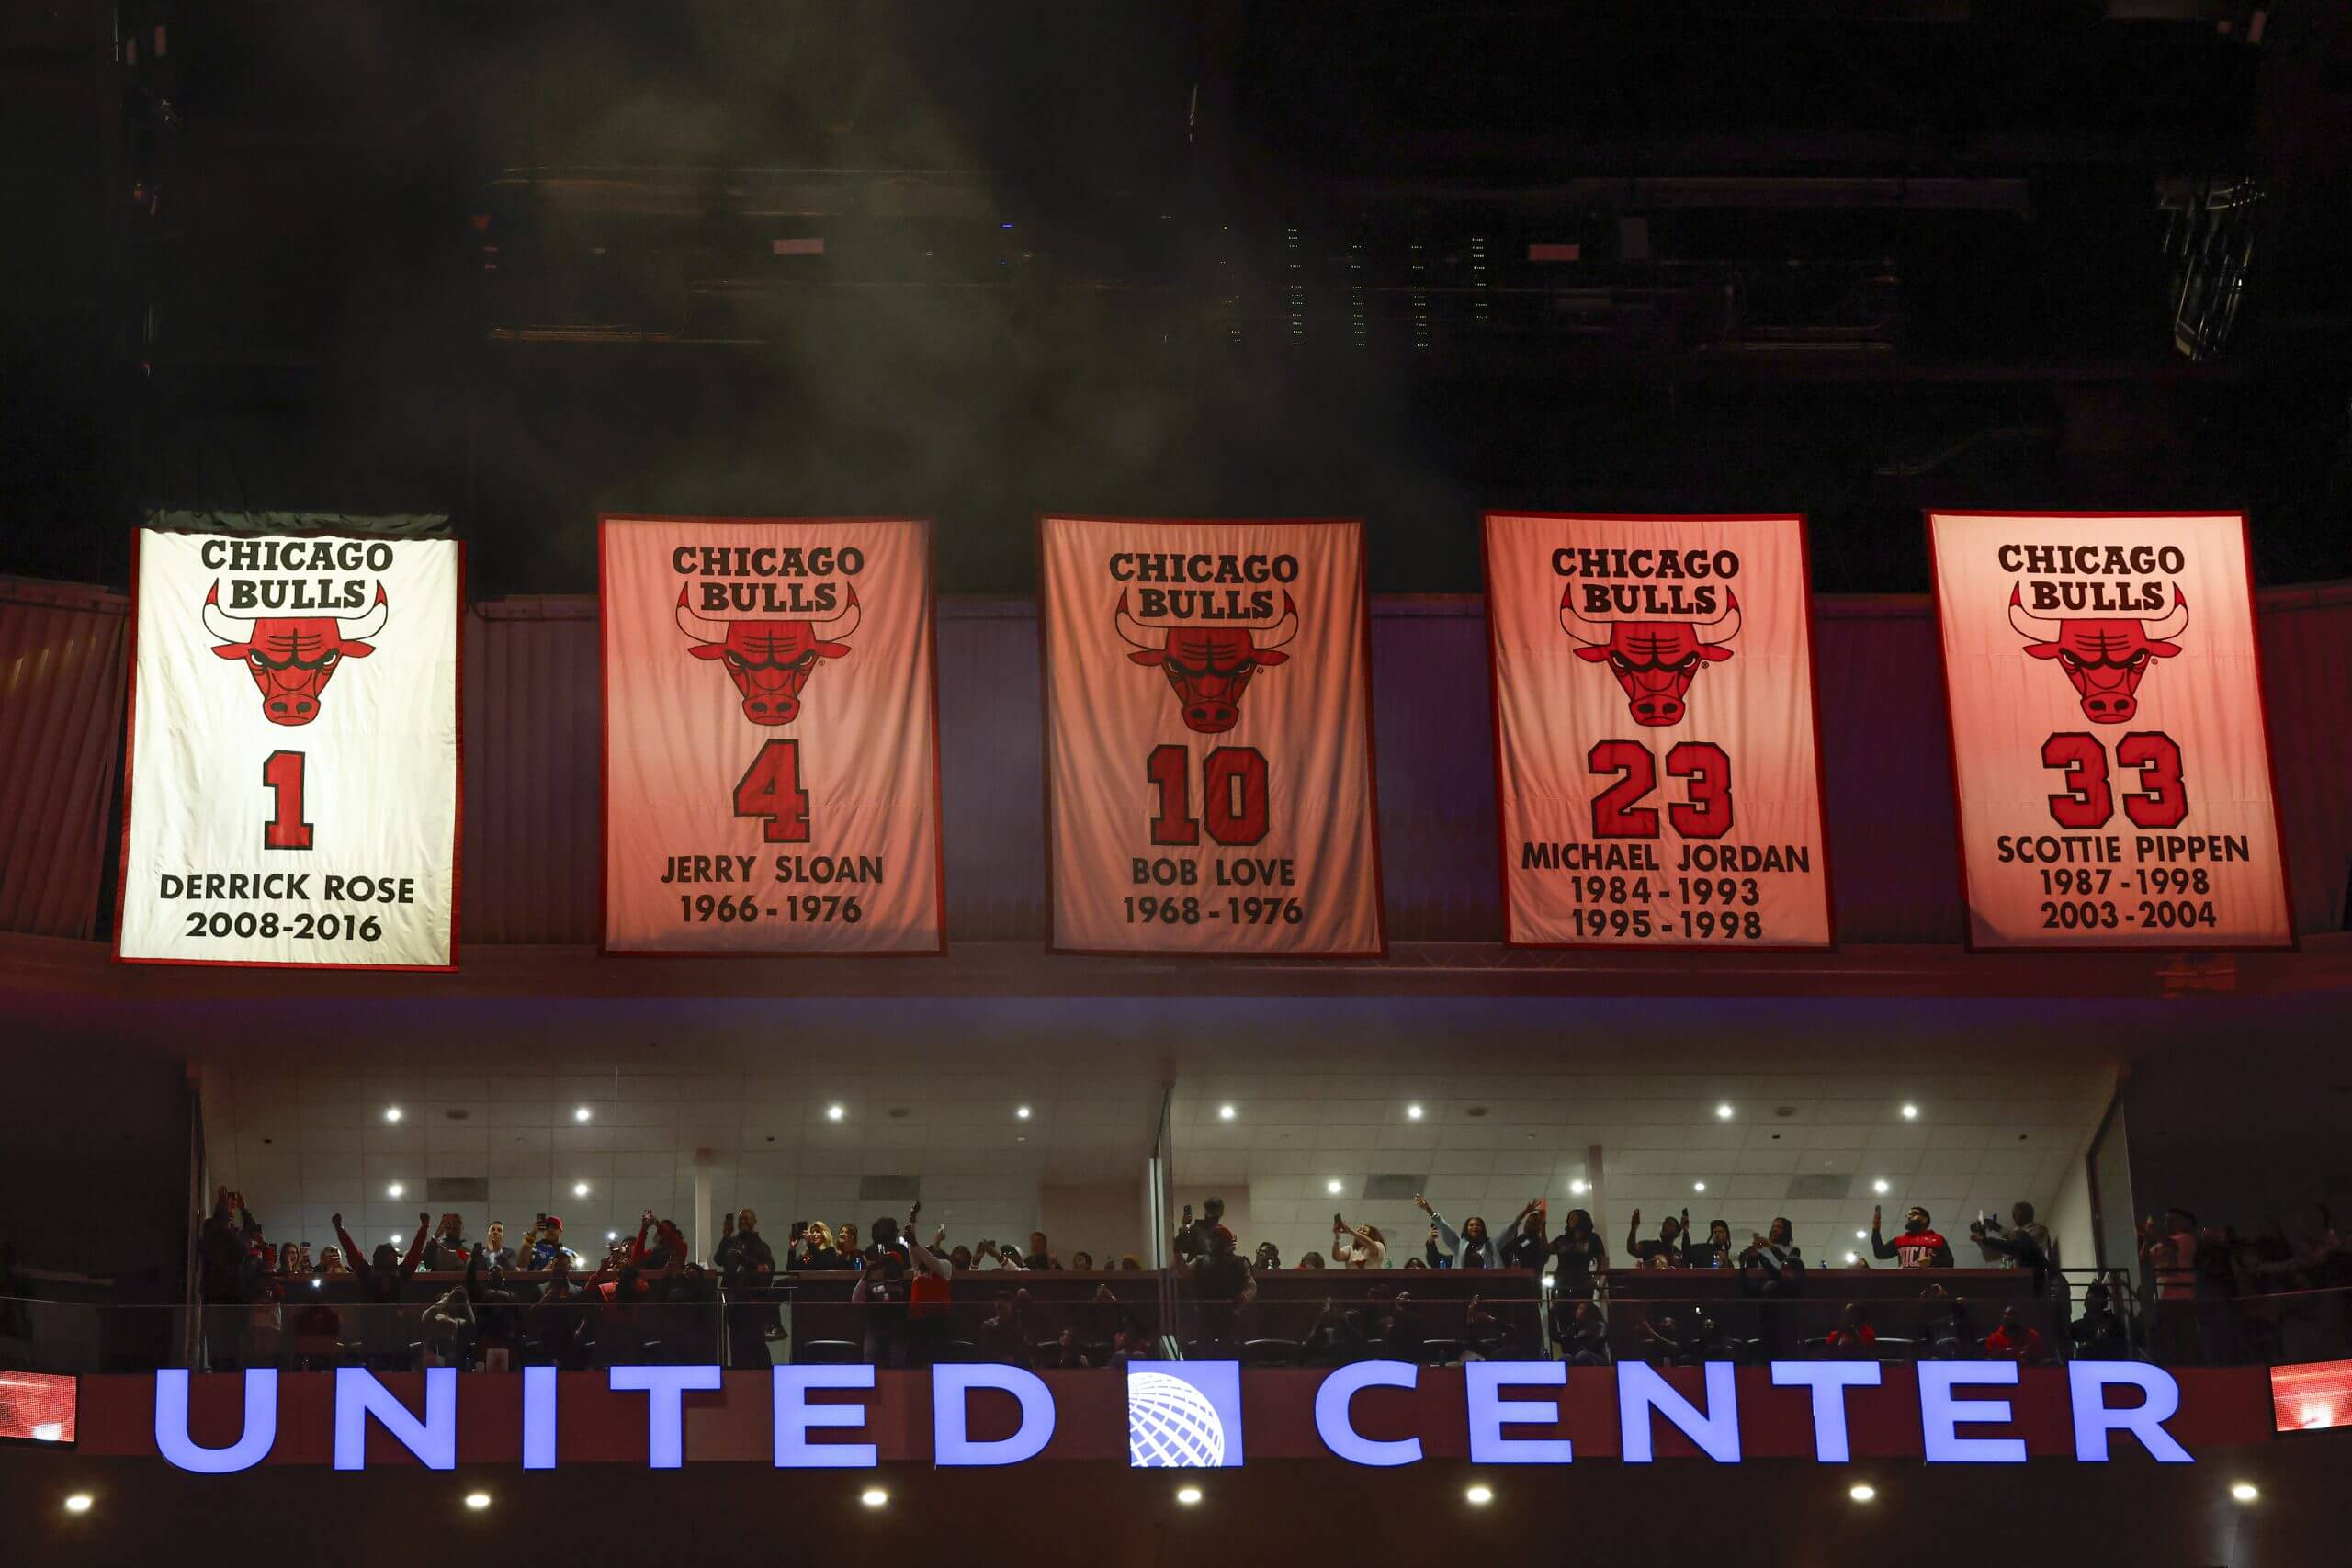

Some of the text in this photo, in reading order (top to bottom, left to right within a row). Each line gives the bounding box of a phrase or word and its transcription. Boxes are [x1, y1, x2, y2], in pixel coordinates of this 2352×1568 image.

[201, 540, 393, 571] CHICAGO
[672, 547, 865, 577] CHICAGO
[1109, 553, 1299, 583] CHICAGO
[1552, 548, 1739, 579] CHICAGO
[1998, 544, 2185, 574] CHICAGO
[229, 579, 366, 609] BULLS
[700, 582, 838, 613] BULLS
[1139, 590, 1274, 620] BULLS
[1583, 583, 1717, 615] BULLS
[2030, 581, 2165, 611] BULLS
[733, 739, 810, 843] 4
[1147, 744, 1270, 846] 10
[1588, 739, 1734, 840] 23
[2041, 731, 2188, 829] 33
[263, 750, 313, 851] 1
[1521, 842, 1809, 873] MICHAEL JORDAN
[1997, 836, 2249, 863] SCOTTIE PIPPEN
[661, 856, 883, 884] JERRY SLOAN
[1132, 858, 1295, 886] BOB LOVE
[160, 874, 414, 903] DERRICK ROSE
[185, 912, 382, 941] 2008-2016
[154, 1359, 2196, 1473] UNITED CENTER
